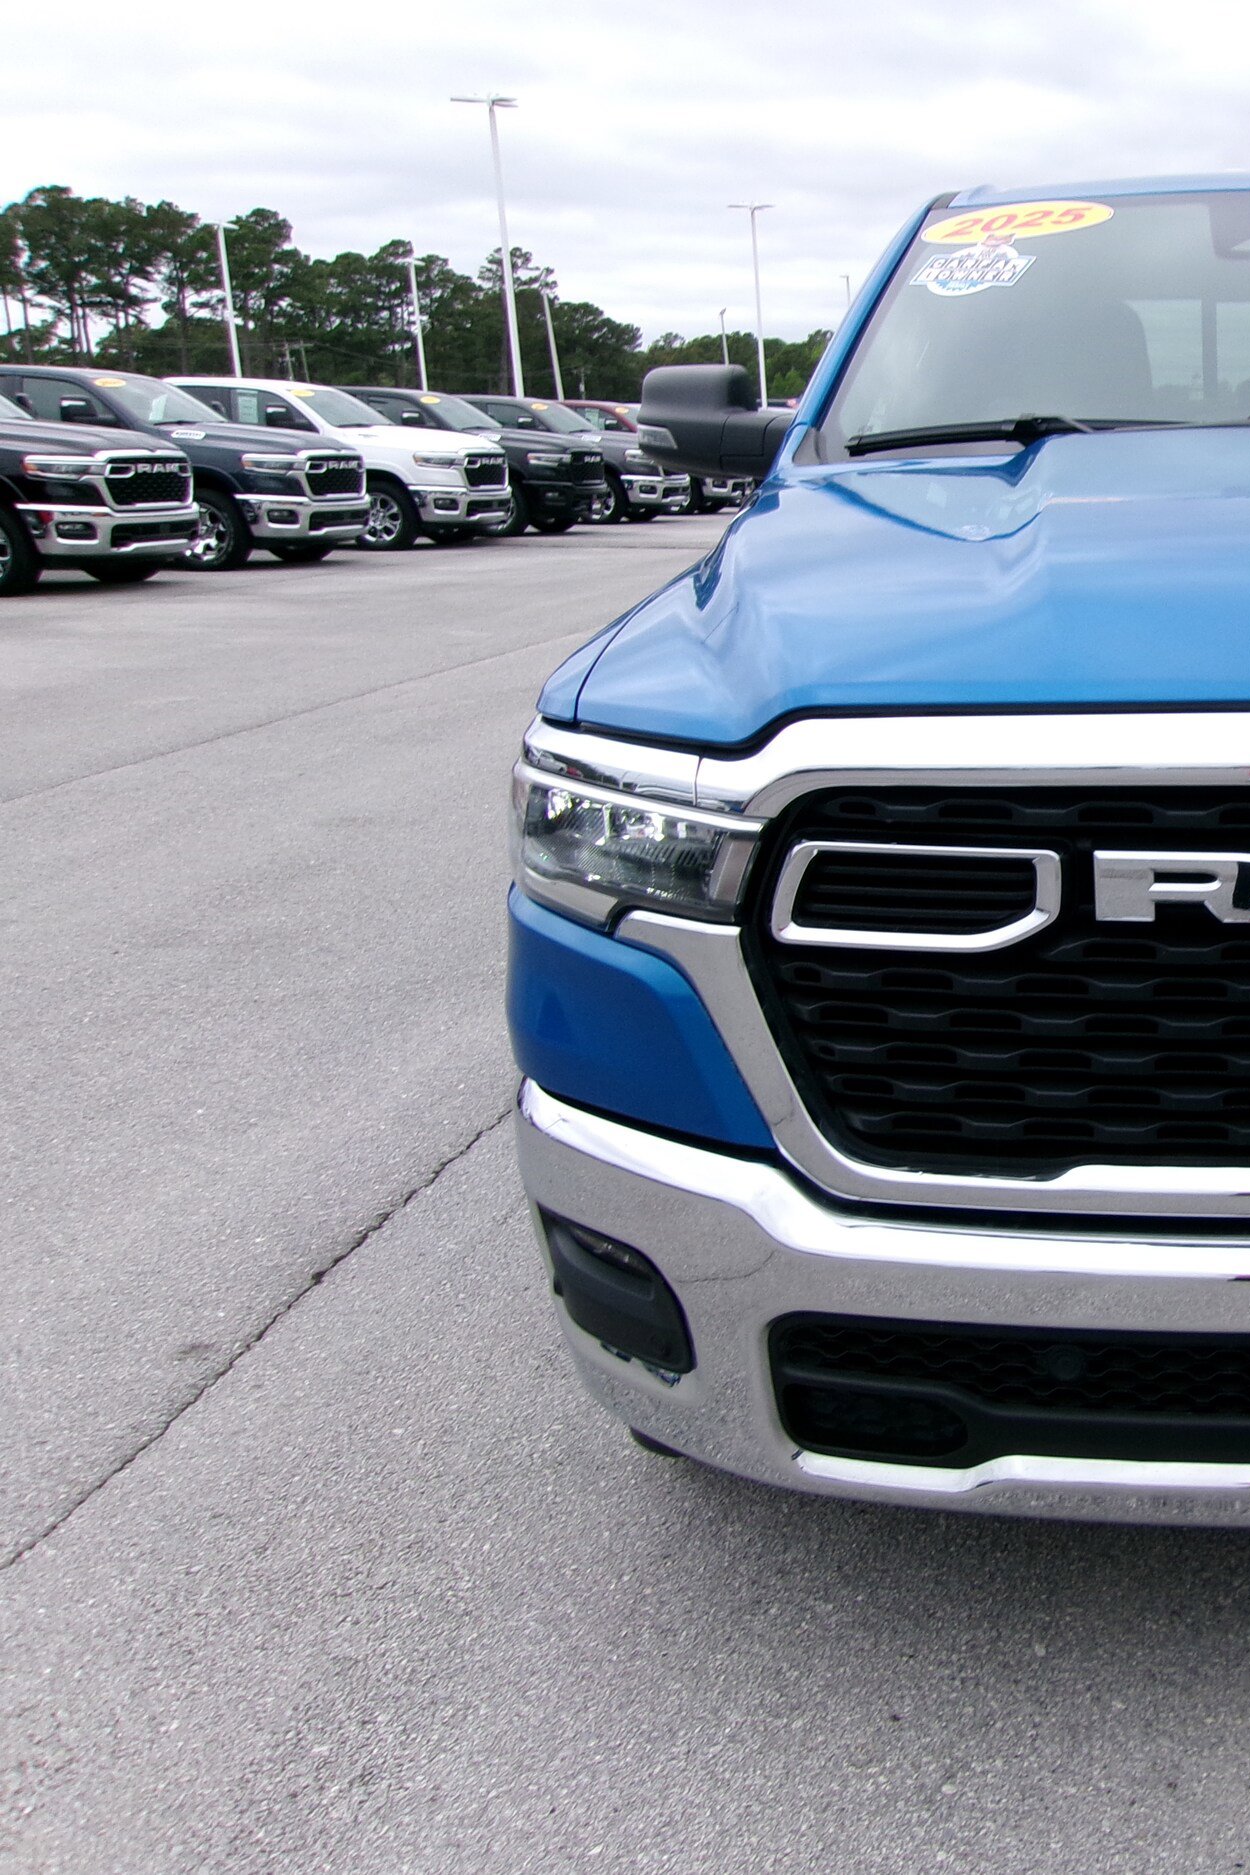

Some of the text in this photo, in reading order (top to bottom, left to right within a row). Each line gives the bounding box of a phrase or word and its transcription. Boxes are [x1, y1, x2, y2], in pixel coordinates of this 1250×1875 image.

[943, 207, 1092, 238] 2025
[137, 463, 180, 474] RAM
[328, 459, 359, 470] RAM
